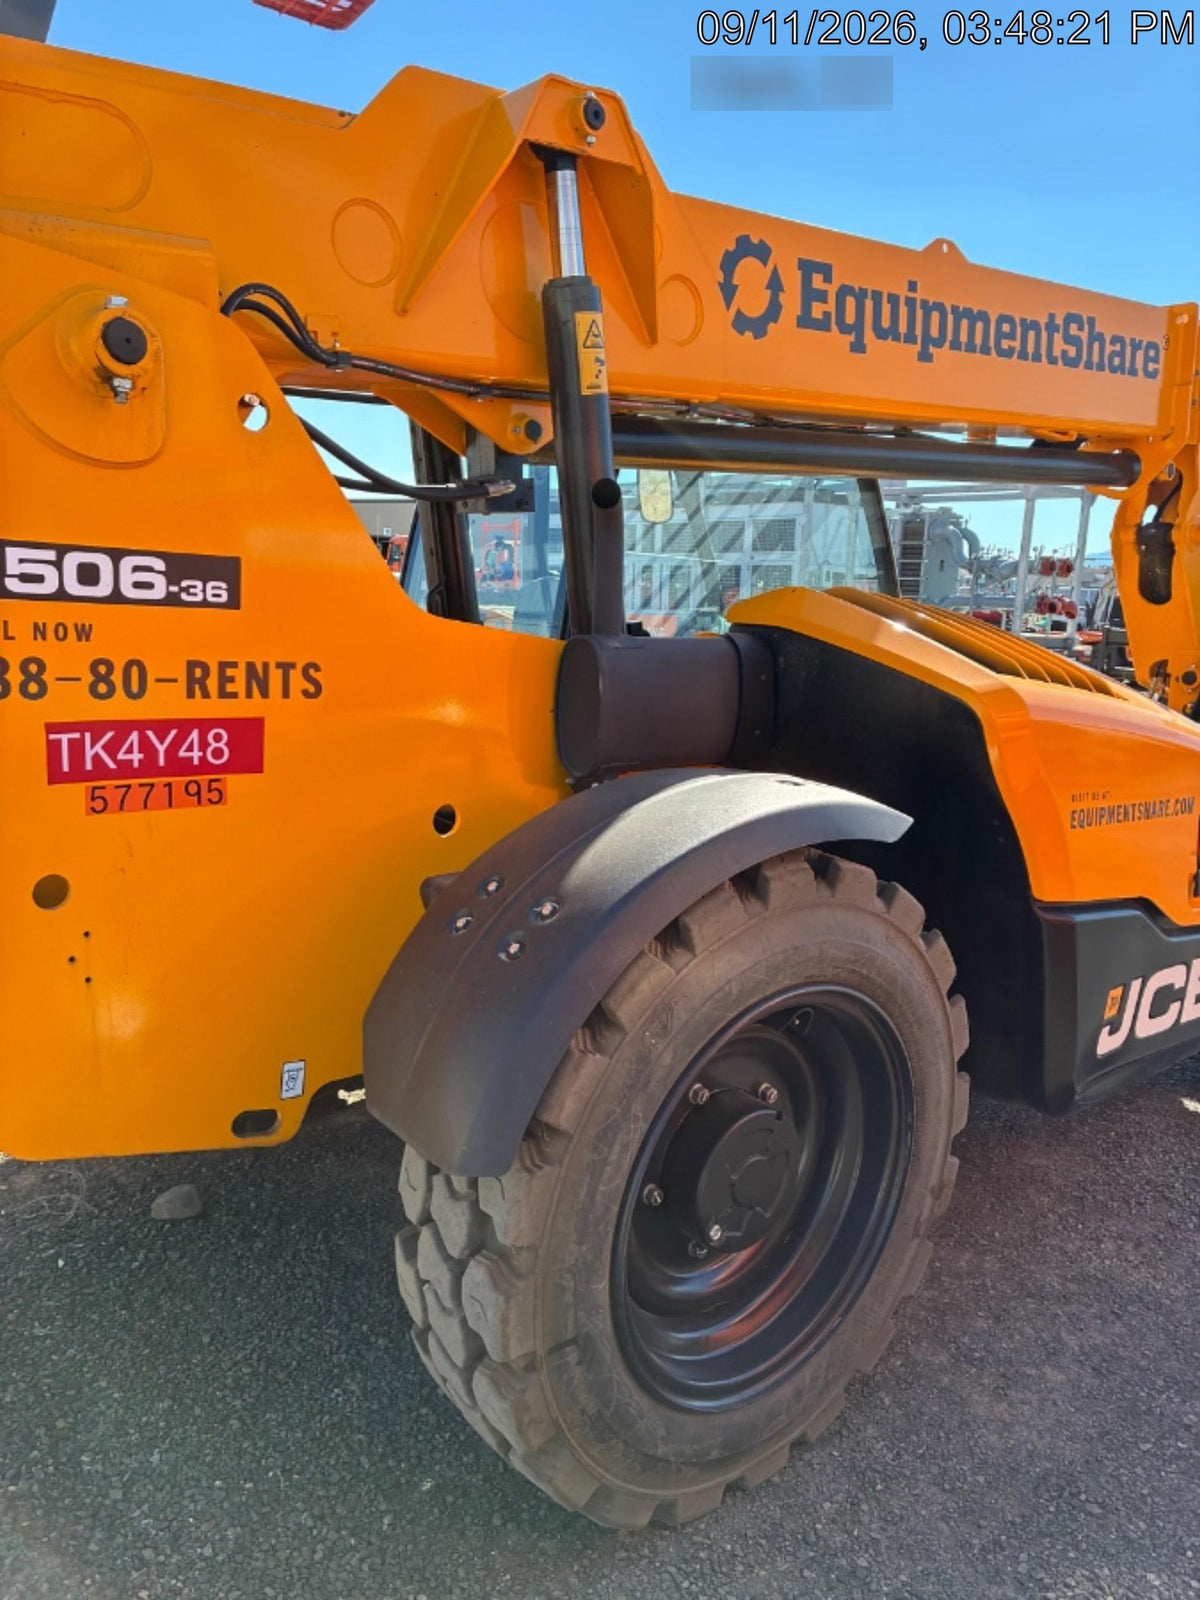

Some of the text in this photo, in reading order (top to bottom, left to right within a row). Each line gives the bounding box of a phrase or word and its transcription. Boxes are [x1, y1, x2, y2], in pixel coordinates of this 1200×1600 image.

[796, 257, 1160, 379] EquipmentShare
[4, 546, 229, 603] 506-36
[33, 621, 93, 642] NOW
[48, 727, 231, 772] TK4Y48
[89, 778, 224, 814] 577195
